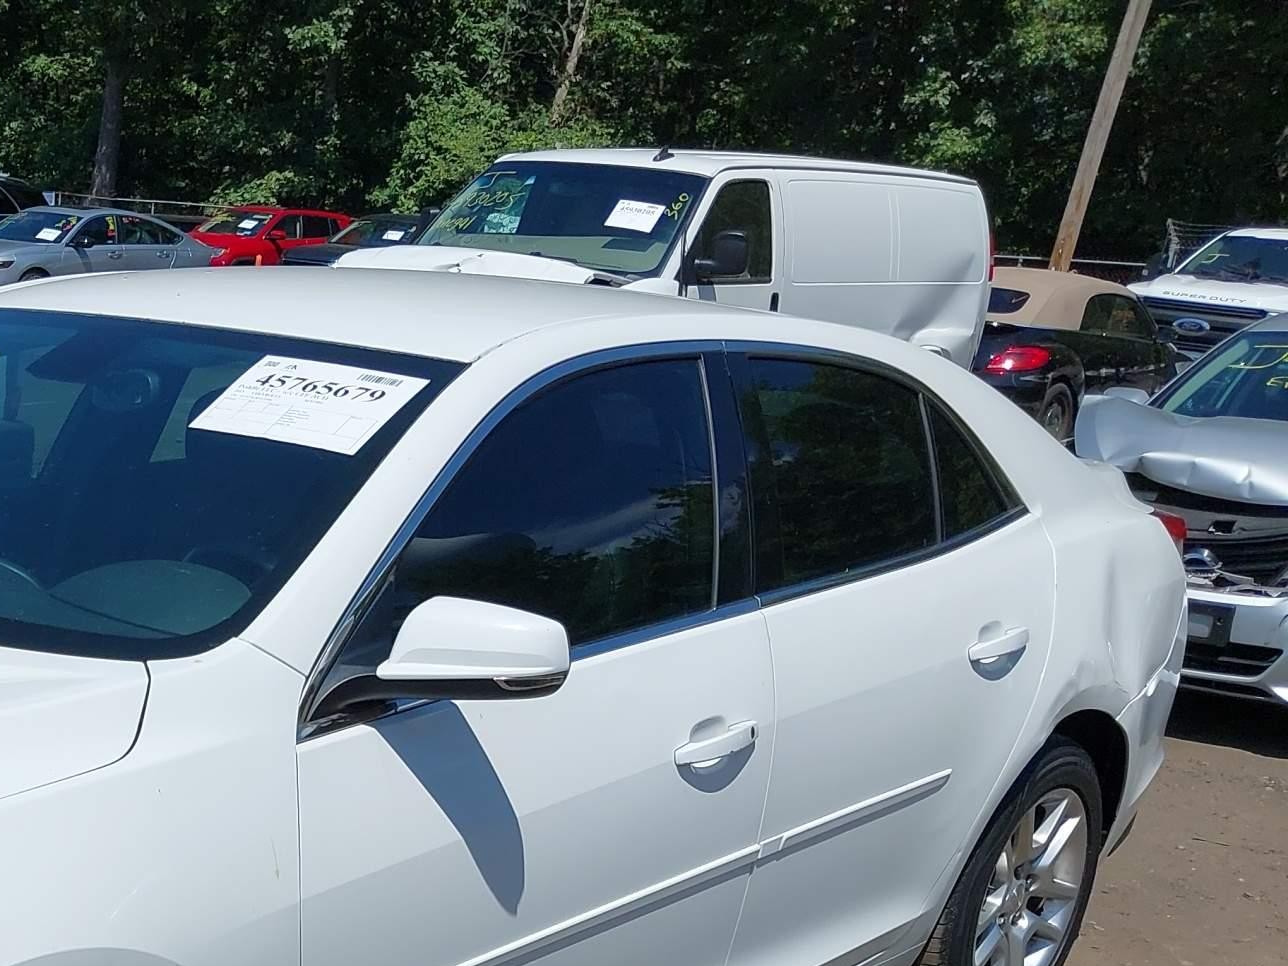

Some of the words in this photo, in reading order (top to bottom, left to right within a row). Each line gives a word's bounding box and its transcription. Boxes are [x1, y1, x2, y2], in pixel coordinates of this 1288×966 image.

[1162, 290, 1206, 299] SUPER
[1209, 295, 1247, 304] DUTY
[255, 372, 387, 403] 45765679
